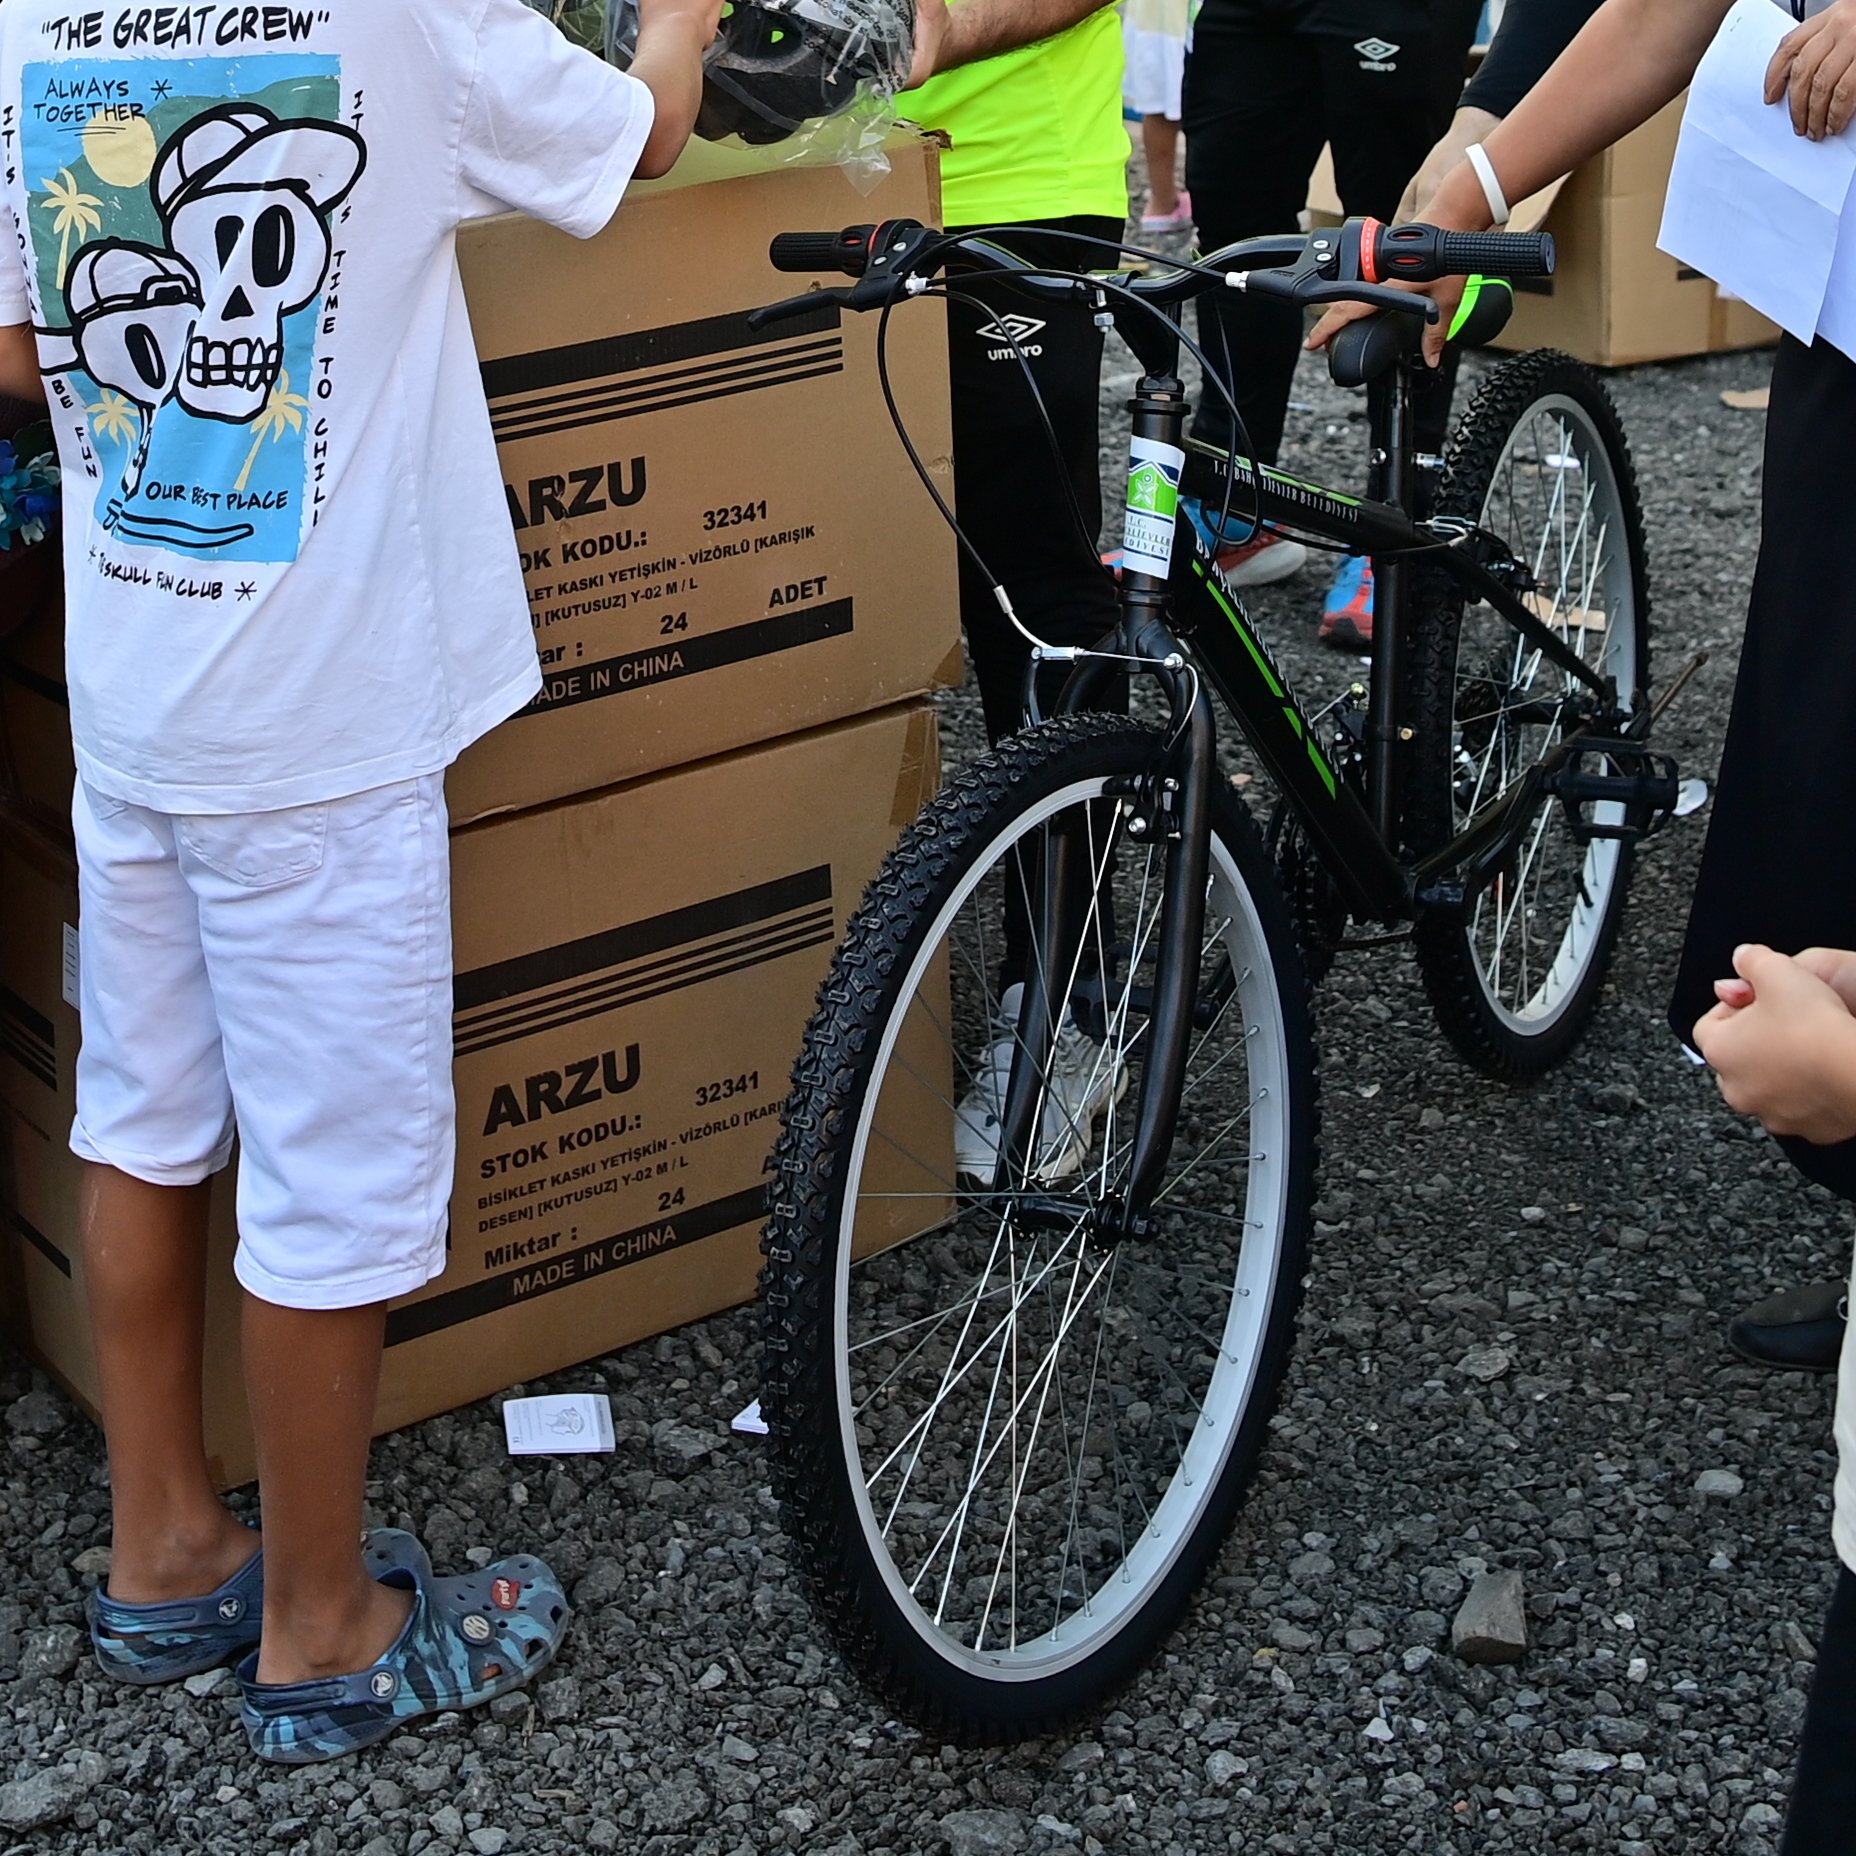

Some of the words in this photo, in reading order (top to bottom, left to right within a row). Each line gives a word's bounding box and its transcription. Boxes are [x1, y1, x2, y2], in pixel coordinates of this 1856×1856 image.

[112, 5, 216, 49] GREAT
[33, 102, 146, 123] TOGETHER
[45, 77, 129, 101] ALWAYS
[322, 250, 346, 334] TIME
[317, 357, 334, 399] TO
[51, 379, 74, 409] BE
[75, 426, 98, 479] FUN
[145, 482, 186, 502] OUR
[226, 490, 289, 511] PLACE
[519, 548, 552, 574] OK
[702, 500, 768, 532] 32341
[104, 561, 152, 586] SKULL
[176, 578, 223, 601] CLUB
[545, 596, 627, 625] [KUTUSUZ]
[631, 585, 662, 604] Y-02
[666, 580, 678, 596] M
[689, 576, 698, 591] L
[558, 574, 604, 597] KASKI
[608, 556, 677, 586] YETİŞKİN
[660, 612, 688, 635] 24
[768, 576, 828, 608] ADET
[532, 676, 581, 706] ADE
[591, 668, 610, 692] IN
[618, 650, 685, 684] CHINA
[483, 1043, 641, 1136] ARZU
[480, 1141, 548, 1179] STOK
[695, 1071, 759, 1107] 32341
[478, 1179, 546, 1210] BİSİKLET
[551, 1163, 596, 1188] KASKI
[600, 1139, 668, 1172] YETİŞKİN
[478, 1208, 533, 1233] DESEN]
[538, 1179, 618, 1217] [KUTUSUZ]
[622, 1167, 653, 1188] Y-02
[656, 1162, 668, 1178] M
[680, 1156, 689, 1169] L
[484, 1230, 561, 1269] Miktar
[658, 1187, 685, 1212] 24
[513, 1260, 575, 1296] MADE
[583, 1248, 604, 1272] IN
[612, 1225, 677, 1261] CHINA
